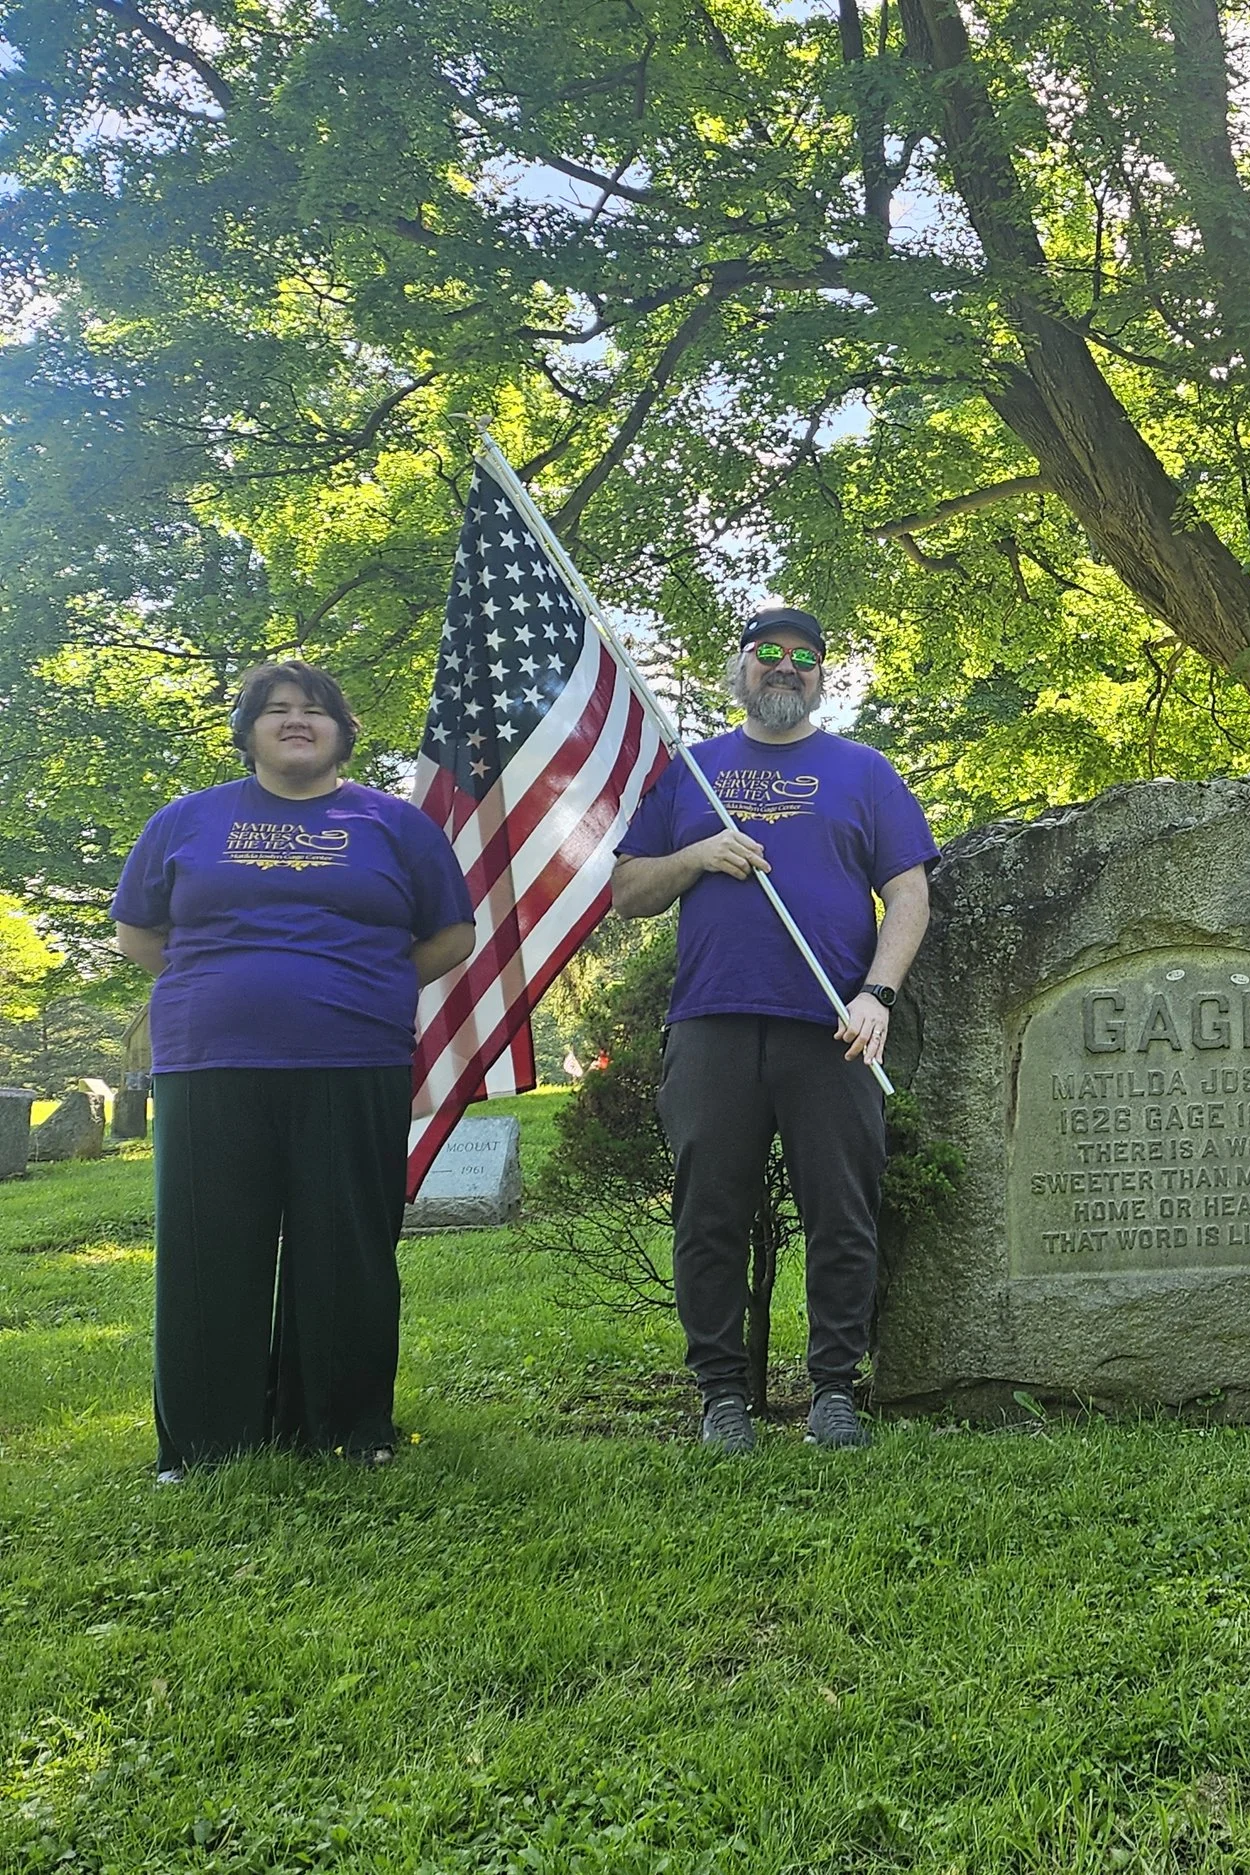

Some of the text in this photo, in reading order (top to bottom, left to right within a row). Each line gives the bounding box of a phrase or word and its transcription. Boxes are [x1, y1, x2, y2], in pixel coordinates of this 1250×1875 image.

[717, 770, 781, 780] MATILDA
[713, 779, 768, 790] SERVES
[742, 791, 771, 801] TEA
[231, 821, 306, 833] MATILDA
[227, 831, 292, 842] SERVES
[226, 839, 297, 851] THE TEA
[1051, 1069, 1188, 1100] MATILDA
[1144, 1102, 1226, 1132] GAGE
[1075, 1139, 1163, 1164] THERE
[1170, 1138, 1194, 1160] IS
[1201, 1138, 1220, 1159] A
[460, 1166, 485, 1175] 1961
[1030, 1167, 1155, 1195] SWEETER
[1160, 1165, 1229, 1190] THAN
[1074, 1198, 1146, 1223] HOME
[1158, 1197, 1192, 1219] OR
[1041, 1229, 1109, 1255] THAT
[1115, 1226, 1189, 1251] WORD
[1196, 1223, 1220, 1247] IS
